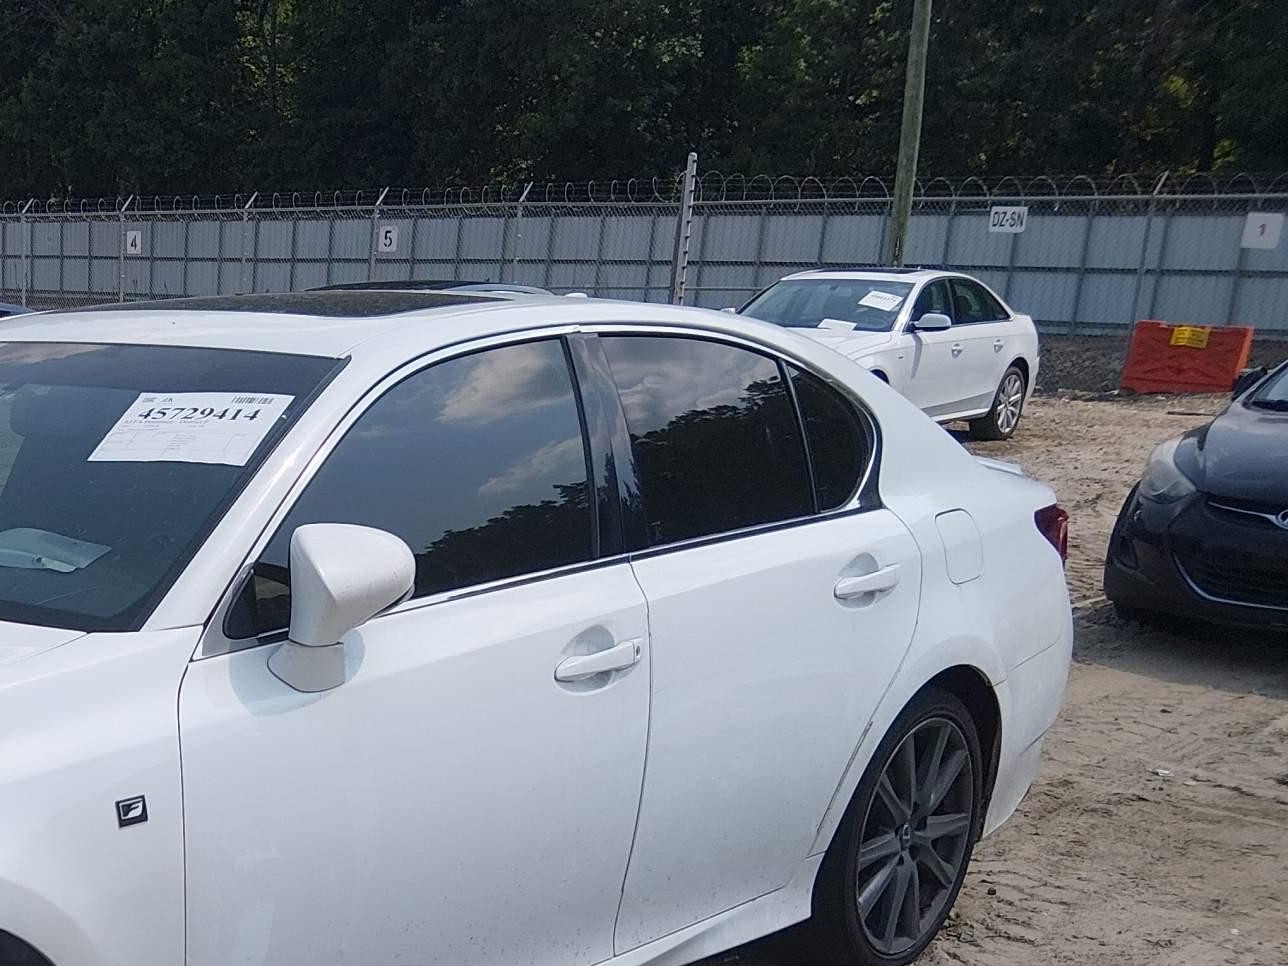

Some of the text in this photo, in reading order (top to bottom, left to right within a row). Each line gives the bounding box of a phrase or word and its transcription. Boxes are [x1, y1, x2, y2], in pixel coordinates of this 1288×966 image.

[991, 211, 1025, 227] DZ-SN
[1257, 223, 1266, 236] 1
[130, 234, 137, 250] 4
[383, 230, 393, 248] 5
[137, 407, 261, 421] 45729414
